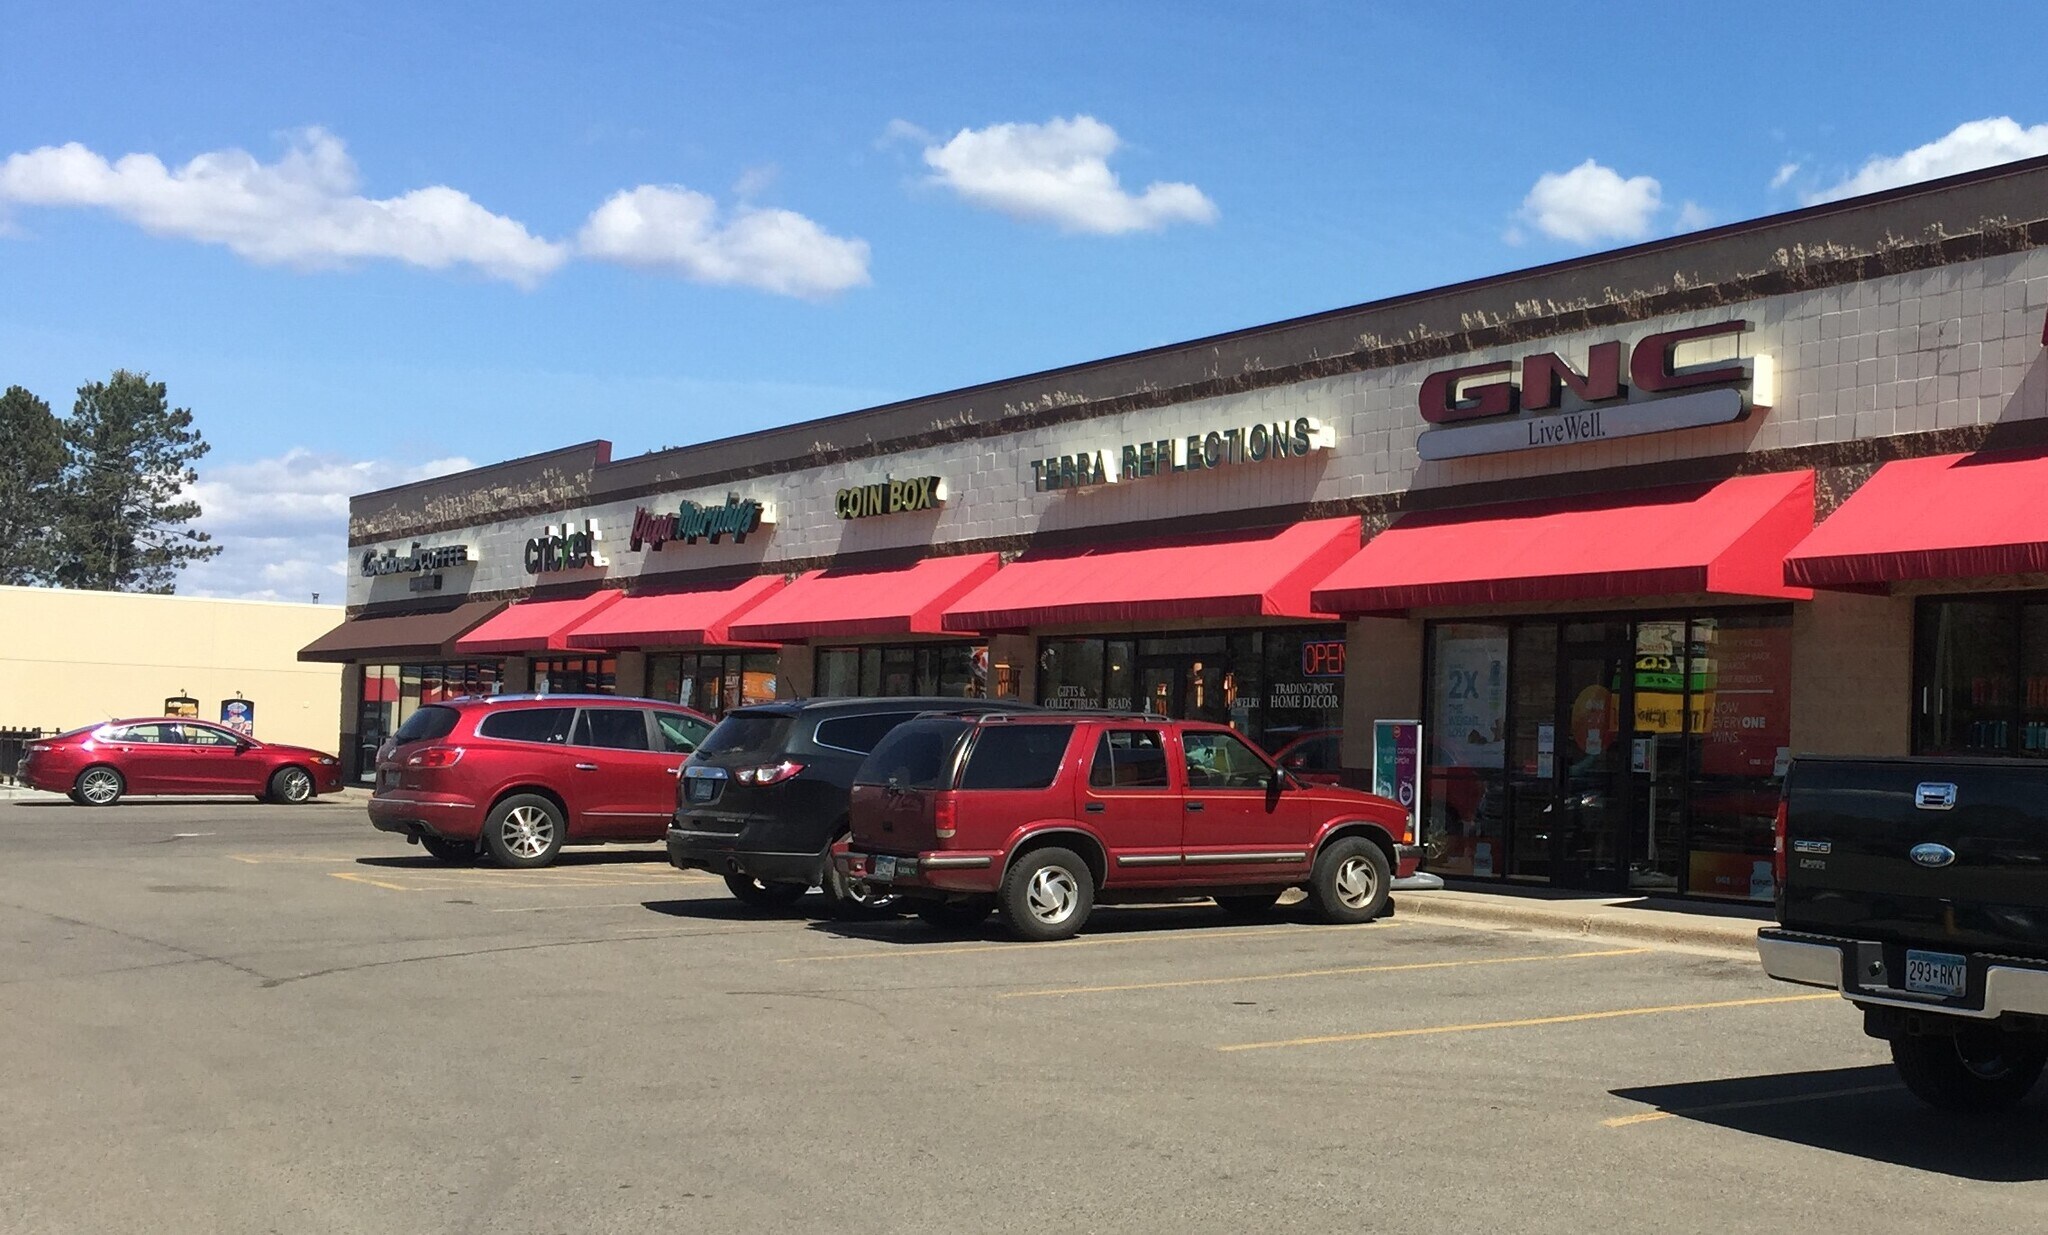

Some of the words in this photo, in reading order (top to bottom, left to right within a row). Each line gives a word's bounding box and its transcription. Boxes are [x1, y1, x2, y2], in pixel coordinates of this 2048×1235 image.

[1419, 319, 1746, 423] GNC
[1031, 450, 1112, 492] TERRA
[1122, 417, 1313, 480] REFLECTIONS
[835, 485, 884, 519] COIN
[889, 476, 936, 513] BOX
[525, 520, 602, 575] cricket
[1304, 643, 1346, 674] OPEN
[1057, 685, 1079, 697] GIFTS
[1274, 682, 1312, 695] TRADING
[1313, 682, 1335, 694] POST
[1448, 669, 1480, 699] 2X
[1107, 697, 1132, 710] BEADS
[1270, 694, 1301, 709] HOME
[1302, 694, 1339, 709] DECOR
[1713, 701, 1739, 713] NOW
[1712, 716, 1766, 729] EVERYONE
[1909, 960, 1931, 982] 293
[1940, 964, 1963, 986] RKY
